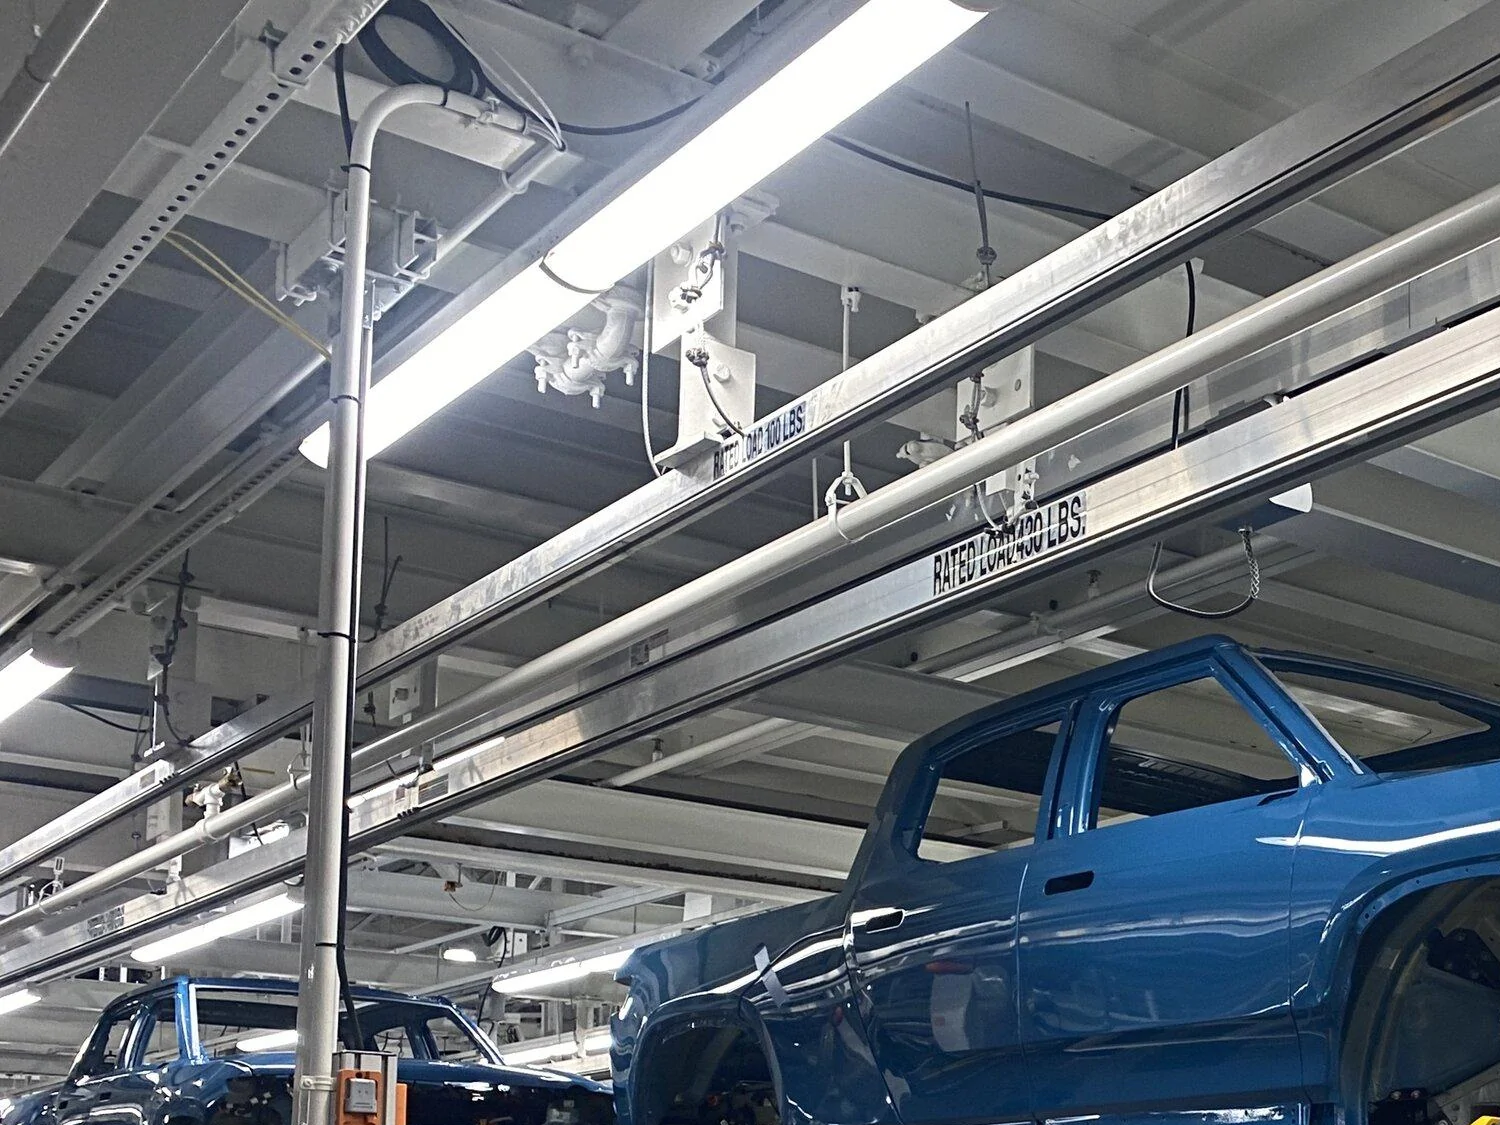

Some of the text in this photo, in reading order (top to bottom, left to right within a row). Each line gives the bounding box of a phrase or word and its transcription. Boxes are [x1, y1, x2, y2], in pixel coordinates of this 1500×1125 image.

[765, 417, 781, 450] 100
[933, 541, 975, 596] RATED
[1047, 496, 1086, 548] LBS.
